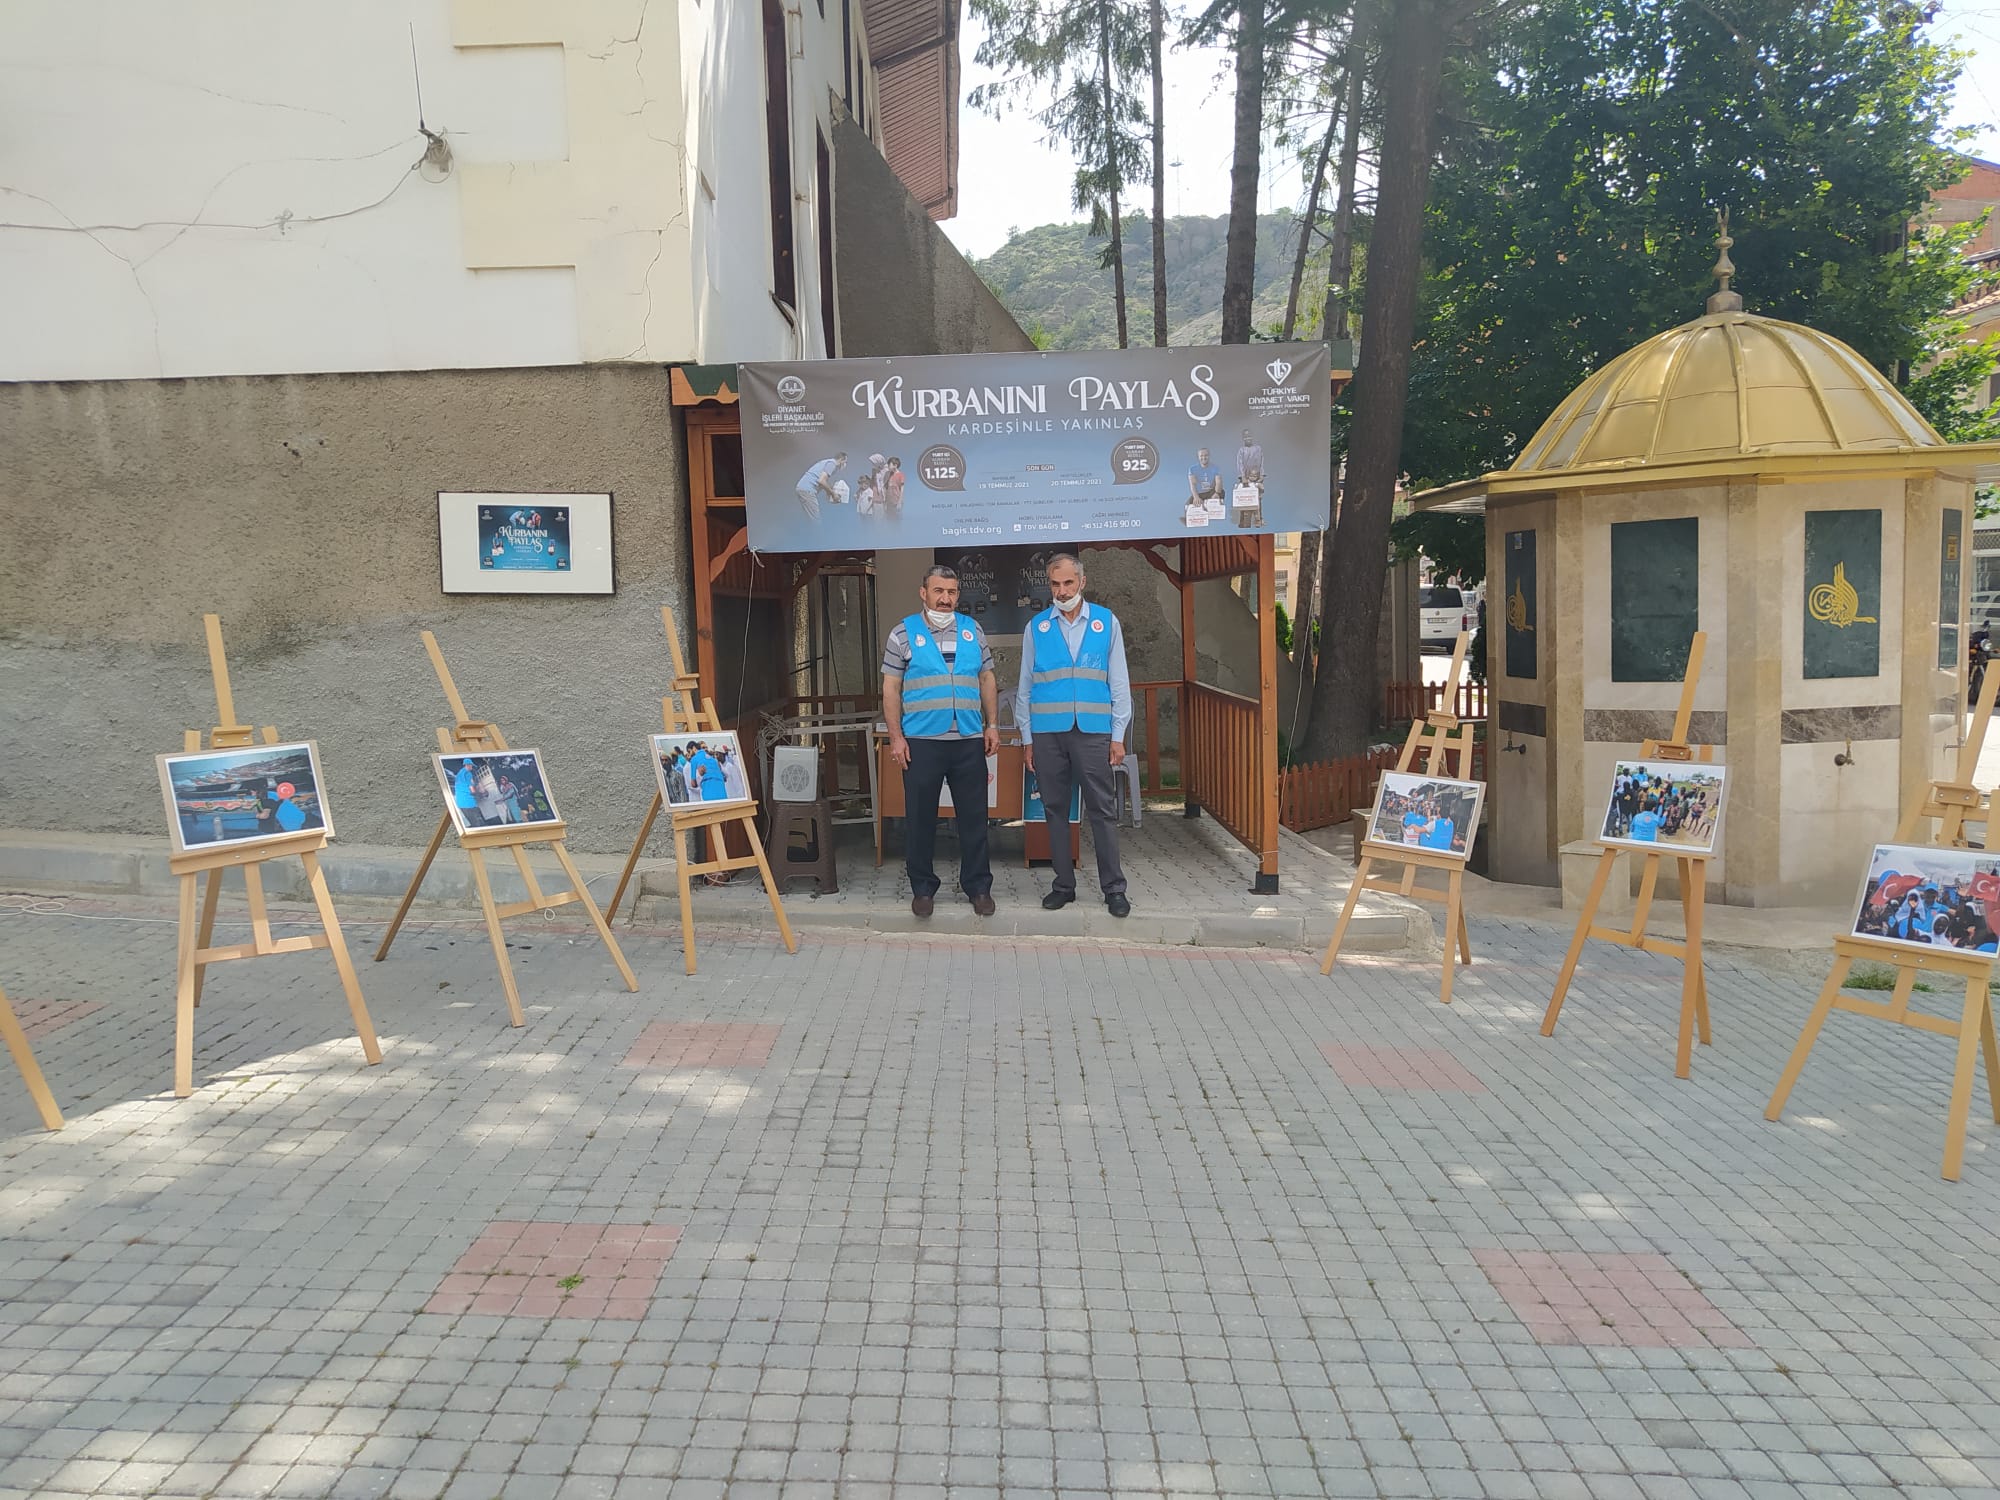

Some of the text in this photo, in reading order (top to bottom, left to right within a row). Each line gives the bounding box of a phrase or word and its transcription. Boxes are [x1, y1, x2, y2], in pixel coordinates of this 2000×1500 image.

[852, 364, 1220, 435] KURBANINI PAYLAŞ
[1248, 396, 1284, 405] DİYANET
[777, 405, 806, 413] DİYANET
[948, 416, 1144, 435] KARDEŞİNLE YAKINLAŞ
[1103, 520, 1118, 528] 416
[1119, 519, 1130, 528] 90
[1130, 519, 1141, 527] 00
